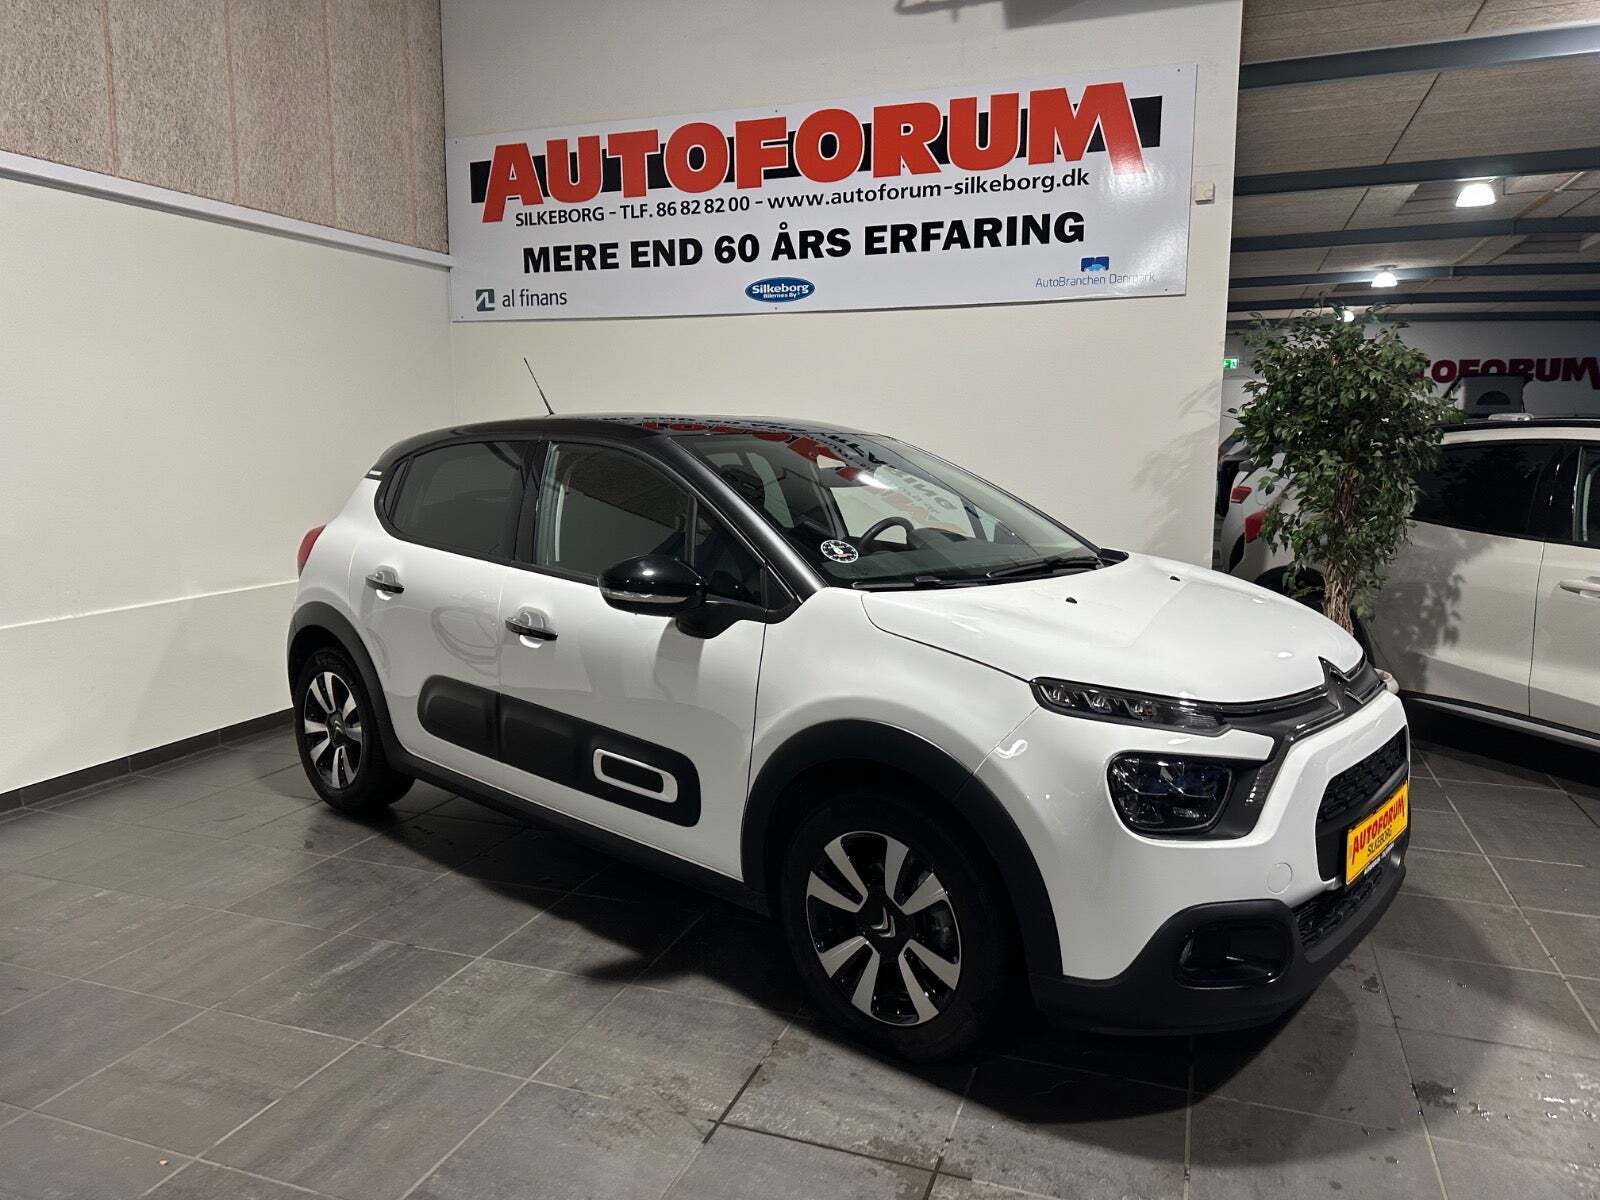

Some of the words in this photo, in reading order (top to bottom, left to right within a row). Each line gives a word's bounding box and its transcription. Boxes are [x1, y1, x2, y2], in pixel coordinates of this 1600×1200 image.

[482, 81, 1146, 223] AUTOFORUM
[515, 206, 605, 227] SILKEBORG
[620, 204, 653, 221] TLF.
[767, 168, 1090, 209] www.autoforum-silkeborg.dk
[523, 242, 620, 274] MERE
[630, 238, 703, 268] END
[714, 233, 760, 264] 60
[771, 222, 851, 260] ÅRS
[864, 211, 1085, 256] ERFARING
[502, 289, 515, 308] al
[519, 288, 568, 307] finans
[752, 283, 810, 294] Silkeborg
[1035, 274, 1106, 288] AutoBranchen
[1351, 795, 1405, 866] AUTOFORUM
